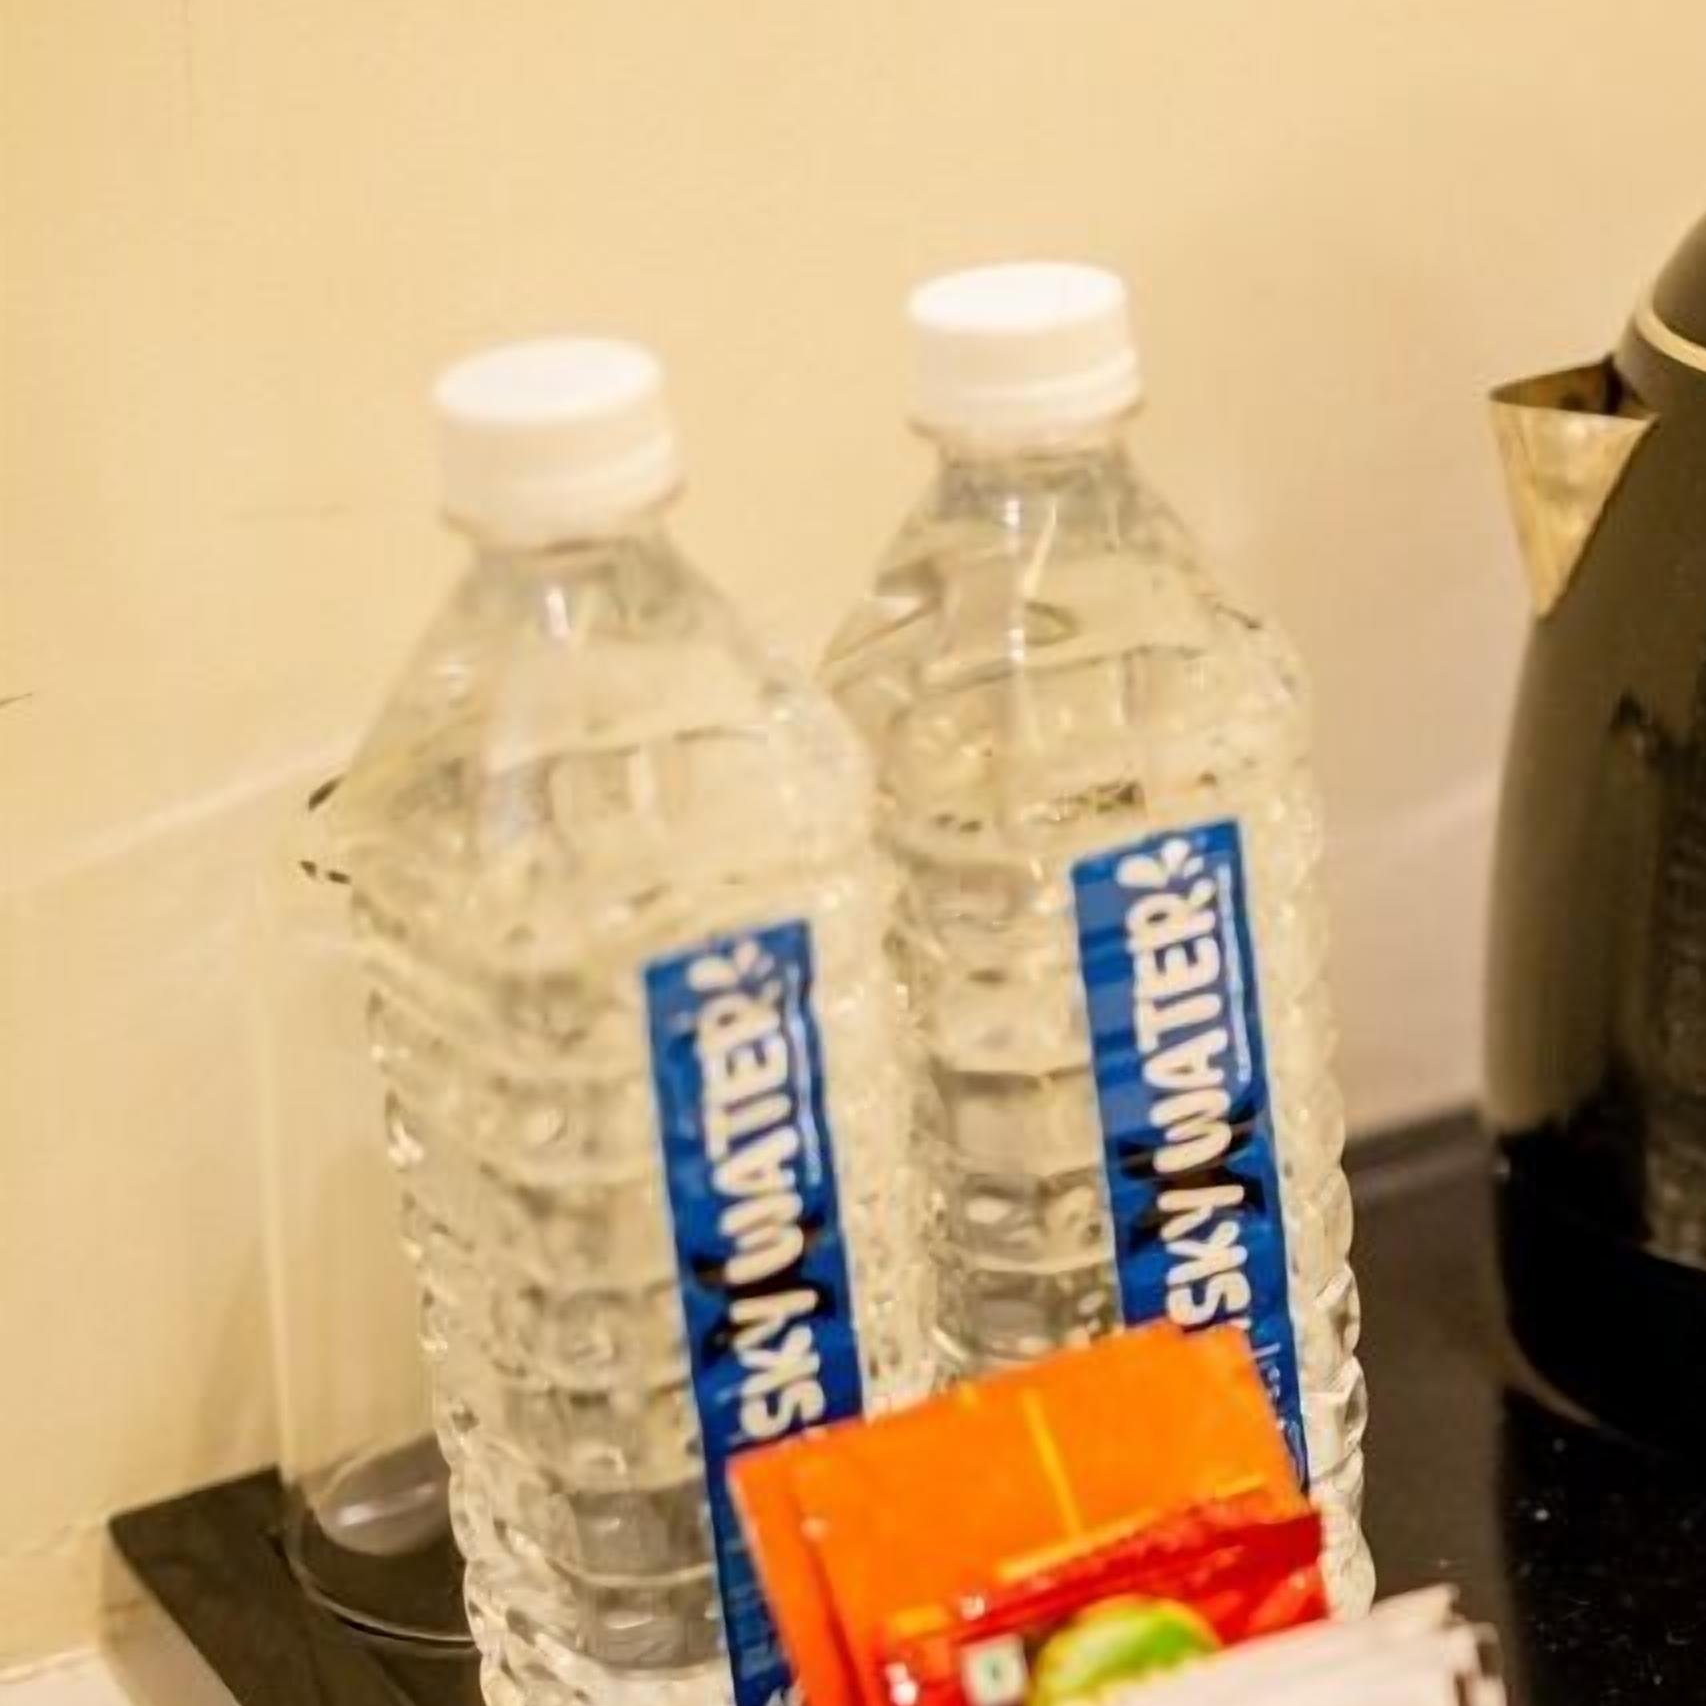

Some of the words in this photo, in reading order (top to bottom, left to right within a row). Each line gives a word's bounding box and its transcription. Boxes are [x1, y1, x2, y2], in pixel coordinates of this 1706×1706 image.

[695, 991, 803, 1285] WATER
[1125, 891, 1232, 1174] WATER
[731, 1288, 826, 1437] SKY
[1157, 1184, 1251, 1326] SKY
